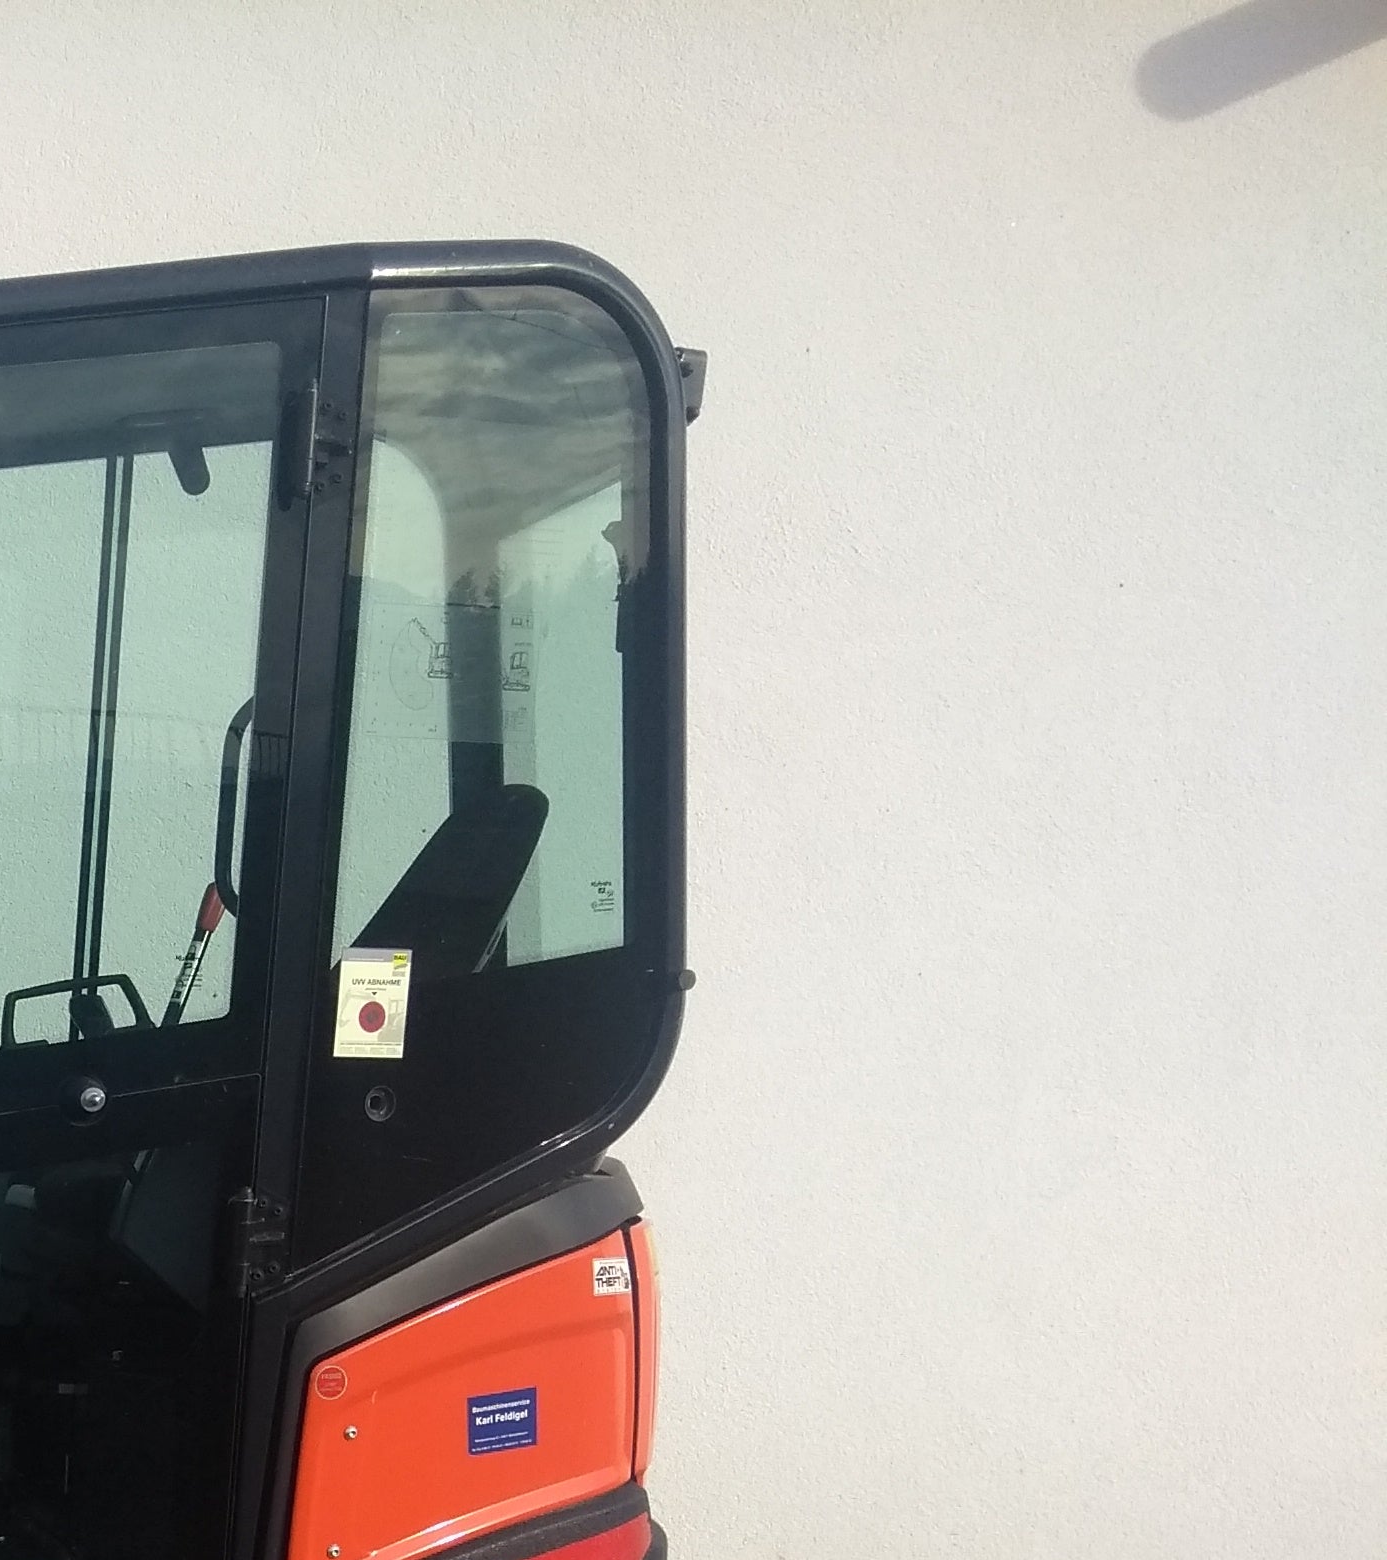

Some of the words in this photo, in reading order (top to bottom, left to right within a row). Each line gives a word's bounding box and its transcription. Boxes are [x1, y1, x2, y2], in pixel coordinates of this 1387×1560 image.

[595, 1276, 621, 1288] THEFT
[475, 1414, 494, 1426] Karl
[495, 1409, 528, 1423] Feldigel
